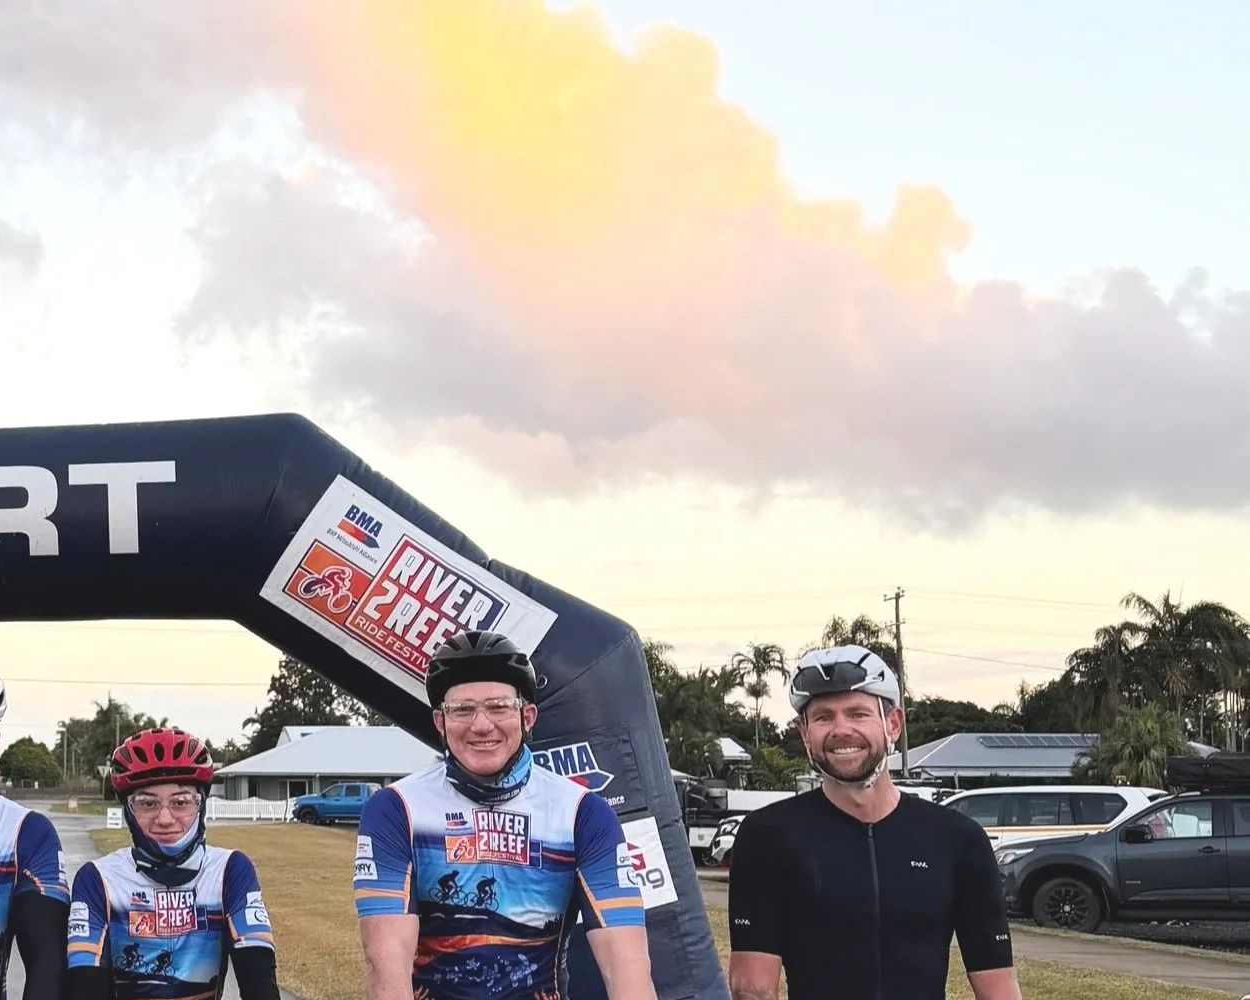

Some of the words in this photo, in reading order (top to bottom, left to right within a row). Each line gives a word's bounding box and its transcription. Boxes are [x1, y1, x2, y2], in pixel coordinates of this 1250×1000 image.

[344, 504, 383, 538] BMA
[389, 546, 493, 632] RIVER
[363, 578, 465, 656] 2REE
[354, 615, 385, 644] RIDE
[384, 634, 430, 669] FESTIV
[533, 745, 595, 776] BMA
[445, 812, 464, 821] BMA
[477, 811, 524, 835] RIVER
[479, 831, 526, 854] 2REEF
[636, 868, 665, 890] ng
[157, 891, 194, 909] RIVER
